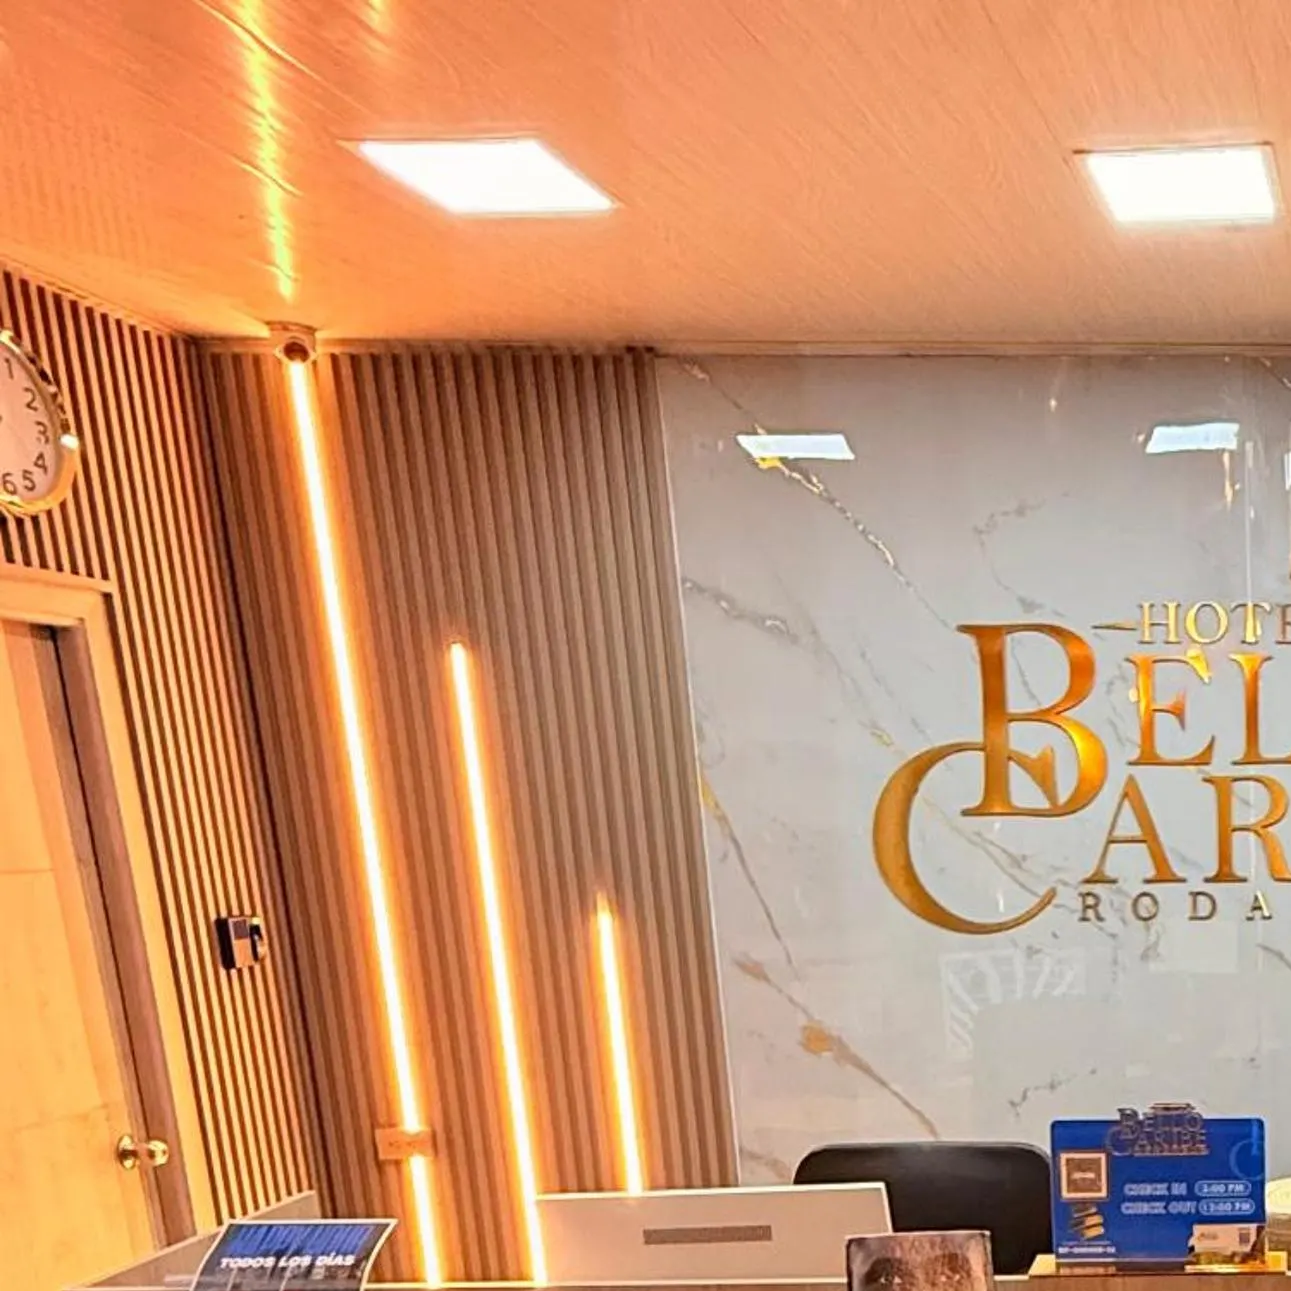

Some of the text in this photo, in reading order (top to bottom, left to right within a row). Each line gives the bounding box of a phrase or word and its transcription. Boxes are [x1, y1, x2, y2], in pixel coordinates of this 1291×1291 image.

[24, 387, 38, 411] 2
[35, 421, 49, 445] 3
[34, 452, 47, 475] 4
[2, 473, 17, 495] 6
[22, 469, 36, 492] 5
[220, 1252, 355, 1268] TODOS LOS DÍAS
